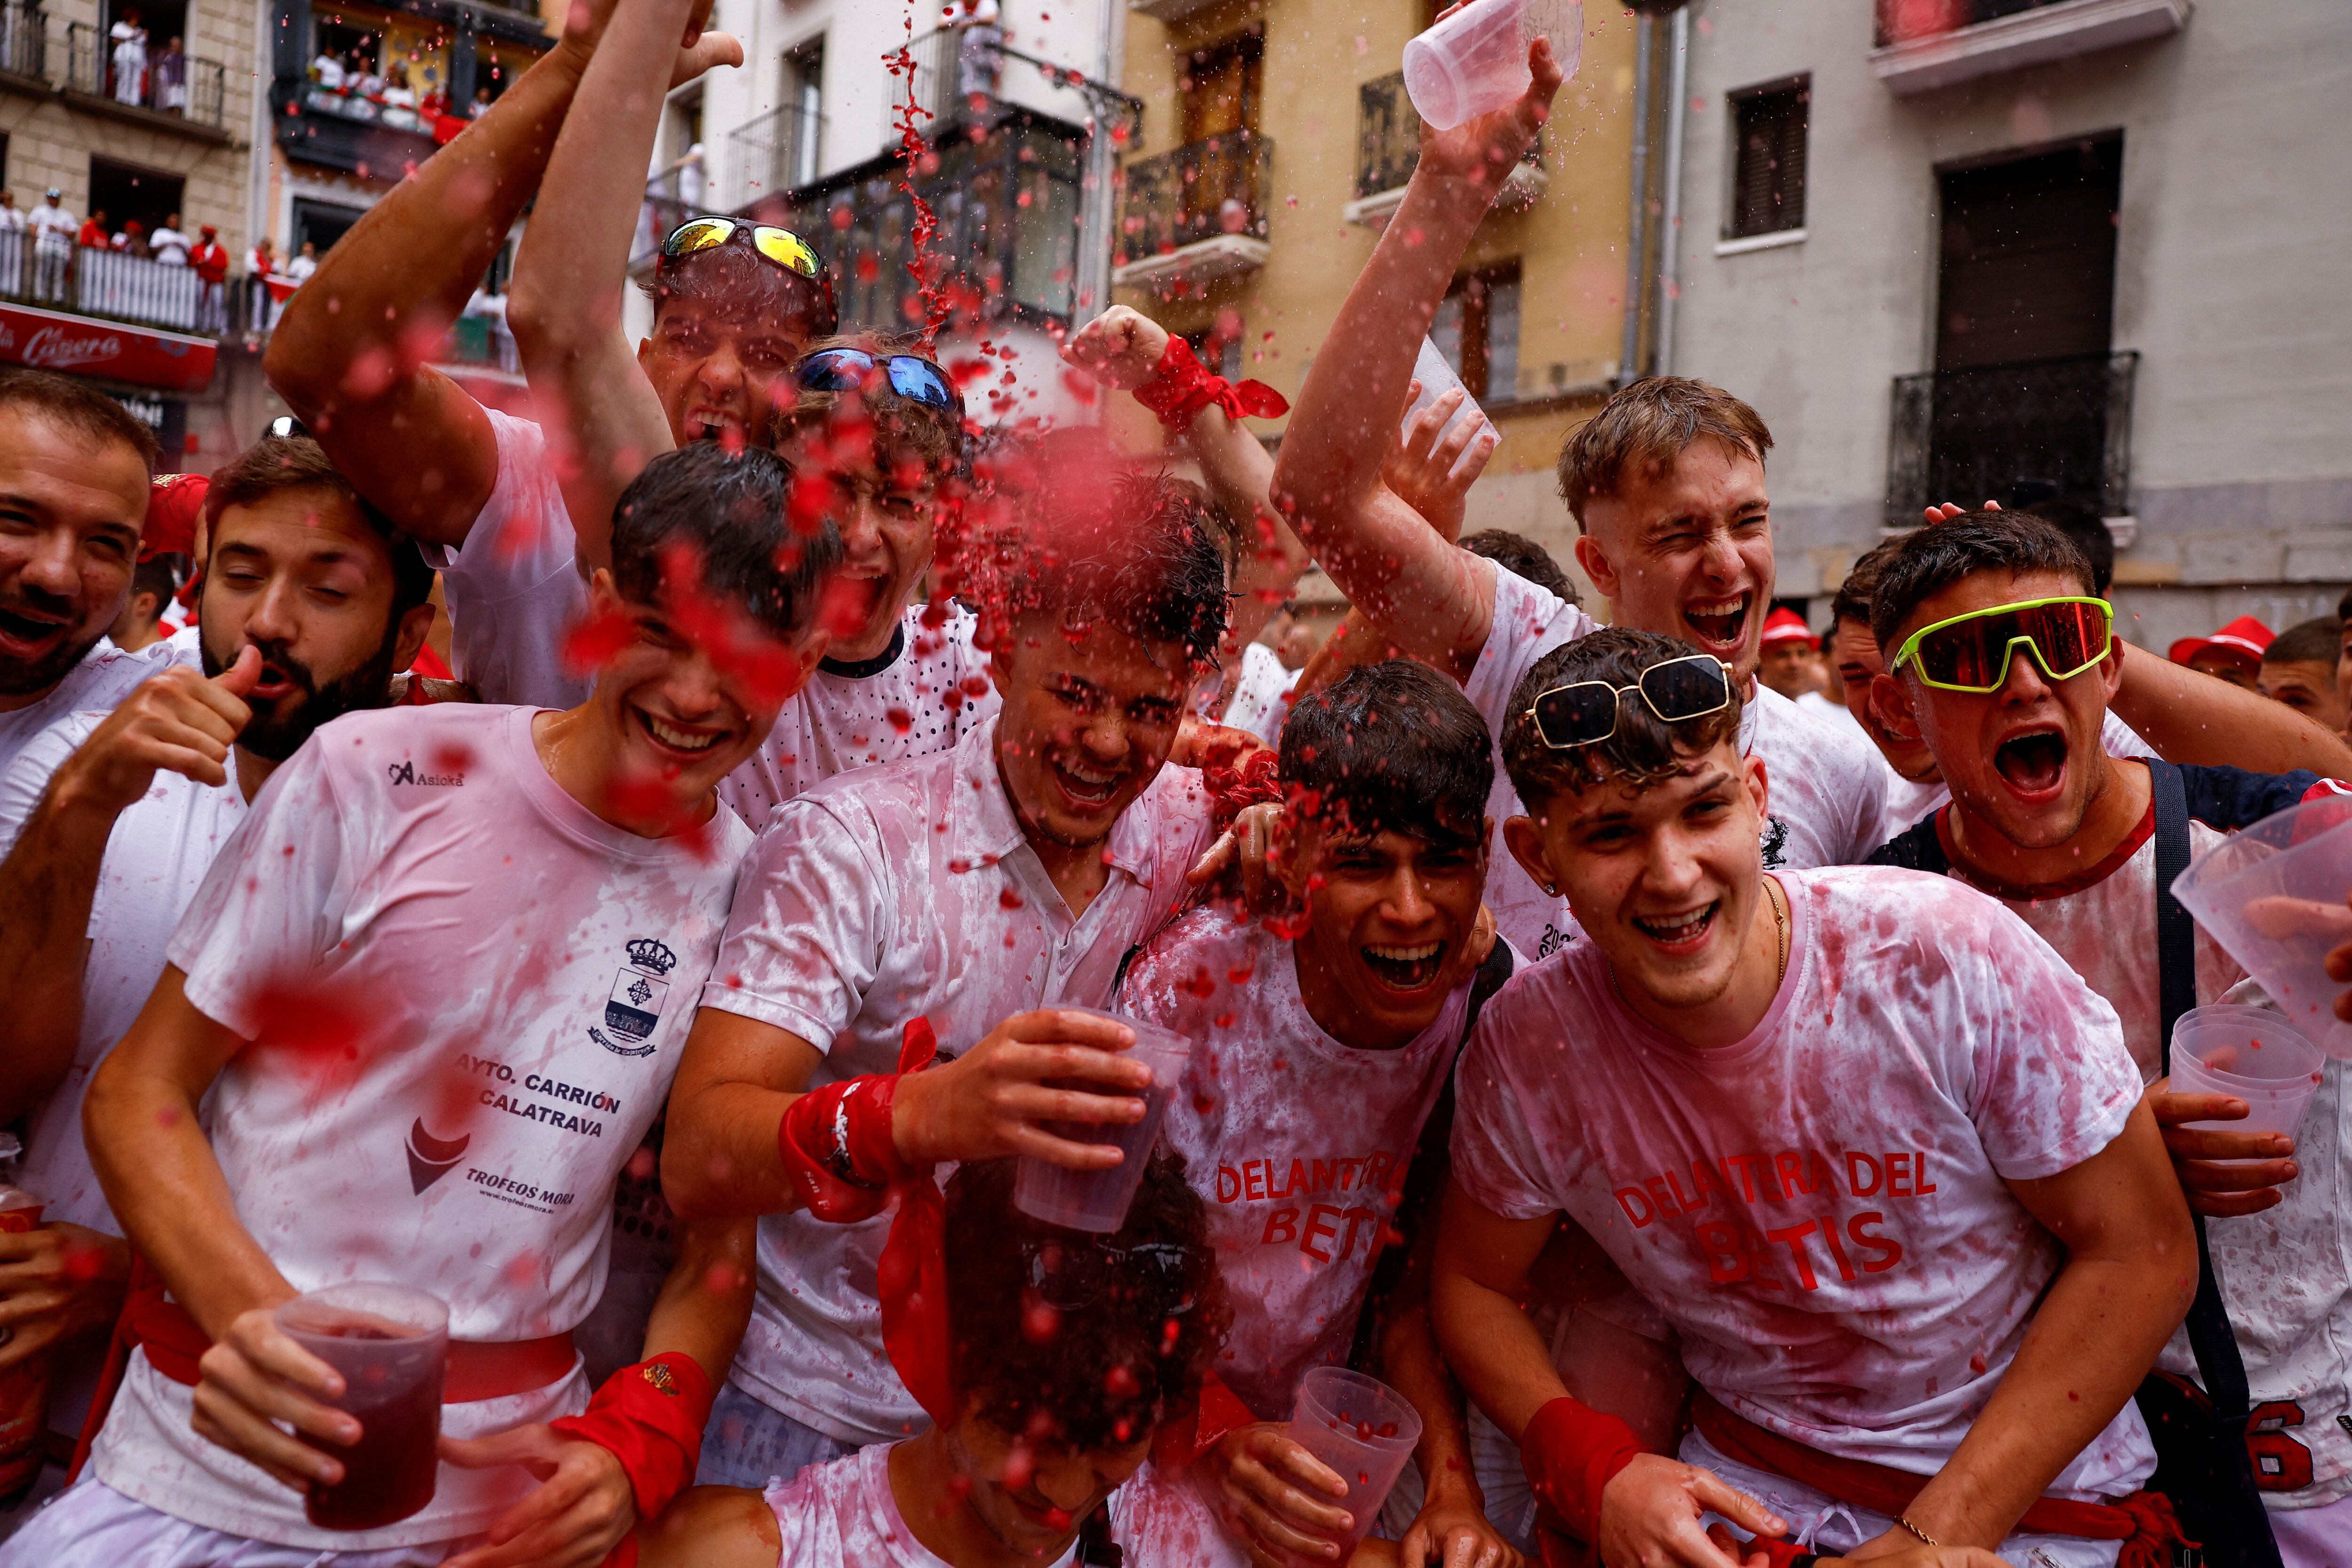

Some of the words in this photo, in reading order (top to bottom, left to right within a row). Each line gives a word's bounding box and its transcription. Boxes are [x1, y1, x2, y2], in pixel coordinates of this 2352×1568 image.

[1542, 923, 1578, 950] 202
[454, 1053, 516, 1085] AYTO.
[524, 1074, 621, 1114] CARRIÓN
[478, 1090, 603, 1138] CALATRAVA
[466, 1168, 539, 1199] TROFEOS
[538, 1190, 575, 1205] MORA
[1845, 1151, 1937, 1198] DEL
[1695, 1211, 1903, 1291] BETIS
[2244, 1398, 2315, 1492] 6
